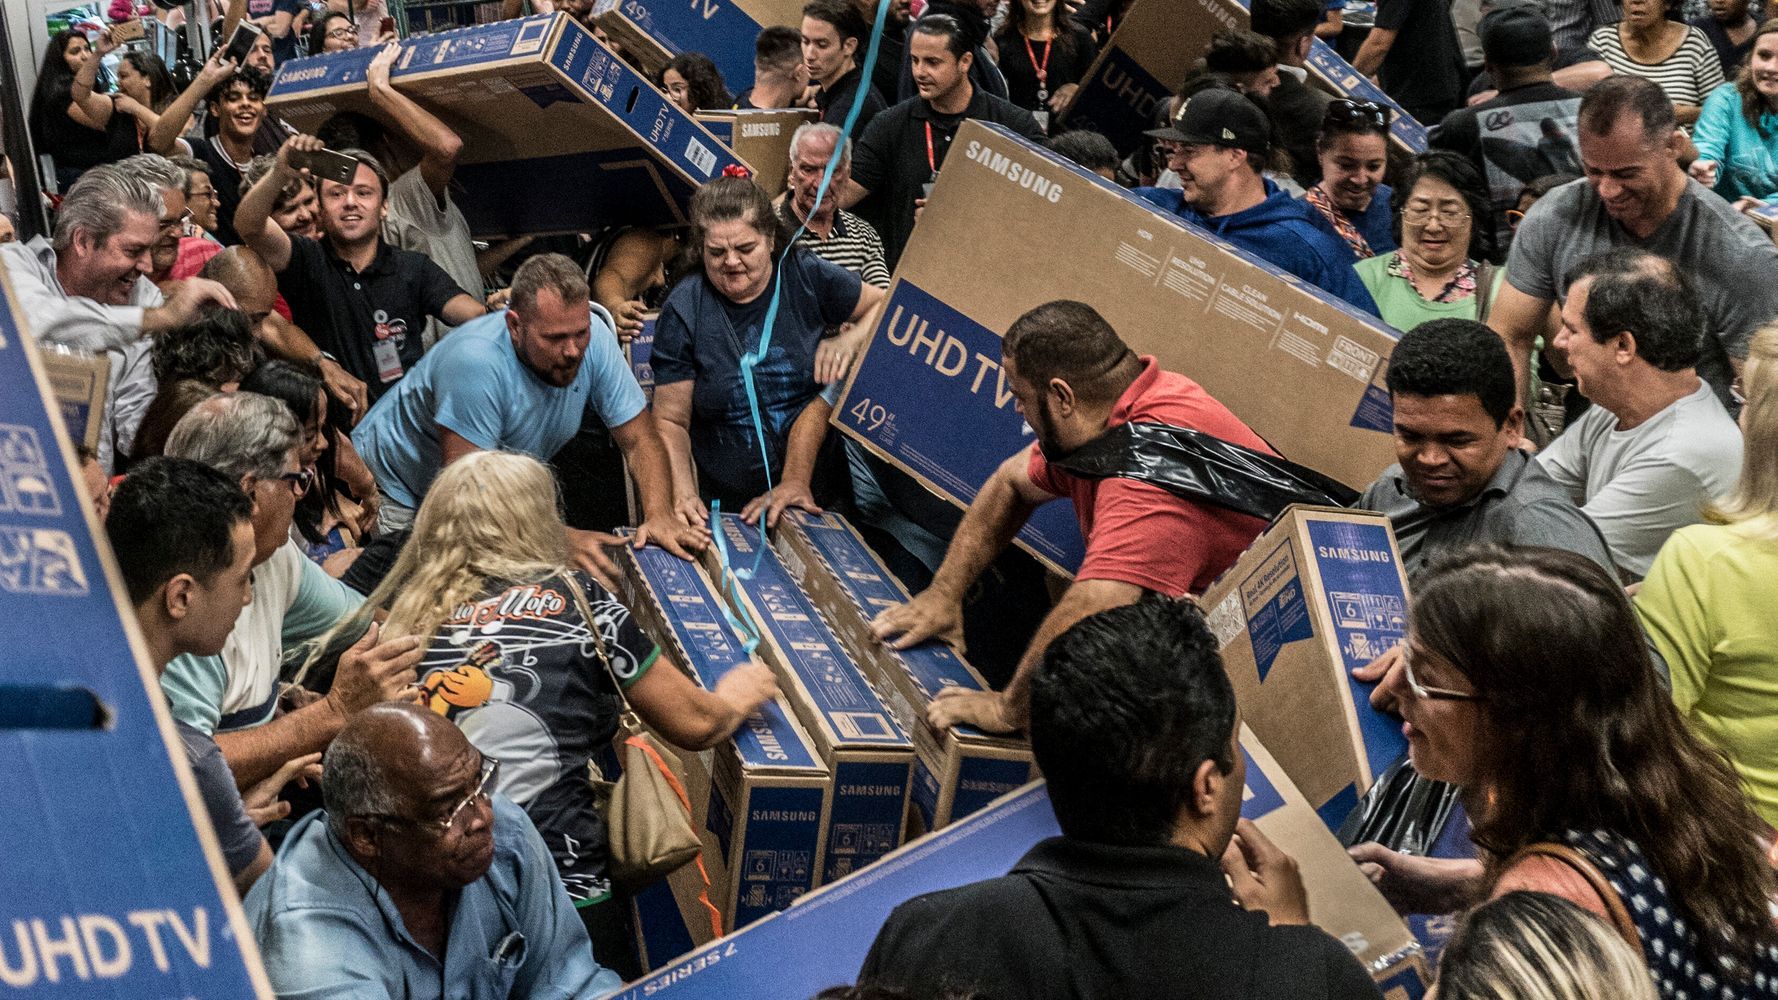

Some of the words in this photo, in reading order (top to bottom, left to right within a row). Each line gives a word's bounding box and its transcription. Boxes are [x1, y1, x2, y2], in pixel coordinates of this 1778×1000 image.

[563, 32, 583, 71] SAMSUNG
[279, 66, 328, 84] SAMSUNG
[650, 118, 664, 142] UHD
[659, 103, 669, 119] TV
[742, 122, 781, 138] SAMSUNG
[965, 140, 1064, 203] SAMSUNG
[887, 305, 968, 377] UHD
[970, 352, 1015, 409] TV
[1337, 339, 1376, 366] FRONT
[1318, 546, 1390, 563] SAMSUNG
[1345, 602, 1357, 617] 6
[750, 711, 789, 761] SAMSU
[840, 785, 901, 796] SAMSUNG
[752, 810, 817, 822] SAMSUNG
[842, 832, 850, 846] 6
[756, 858, 764, 872] 6
[0, 912, 132, 988] UHD
[127, 906, 211, 974] TV
[724, 942, 738, 957] 7
[643, 951, 721, 996] SERIES
